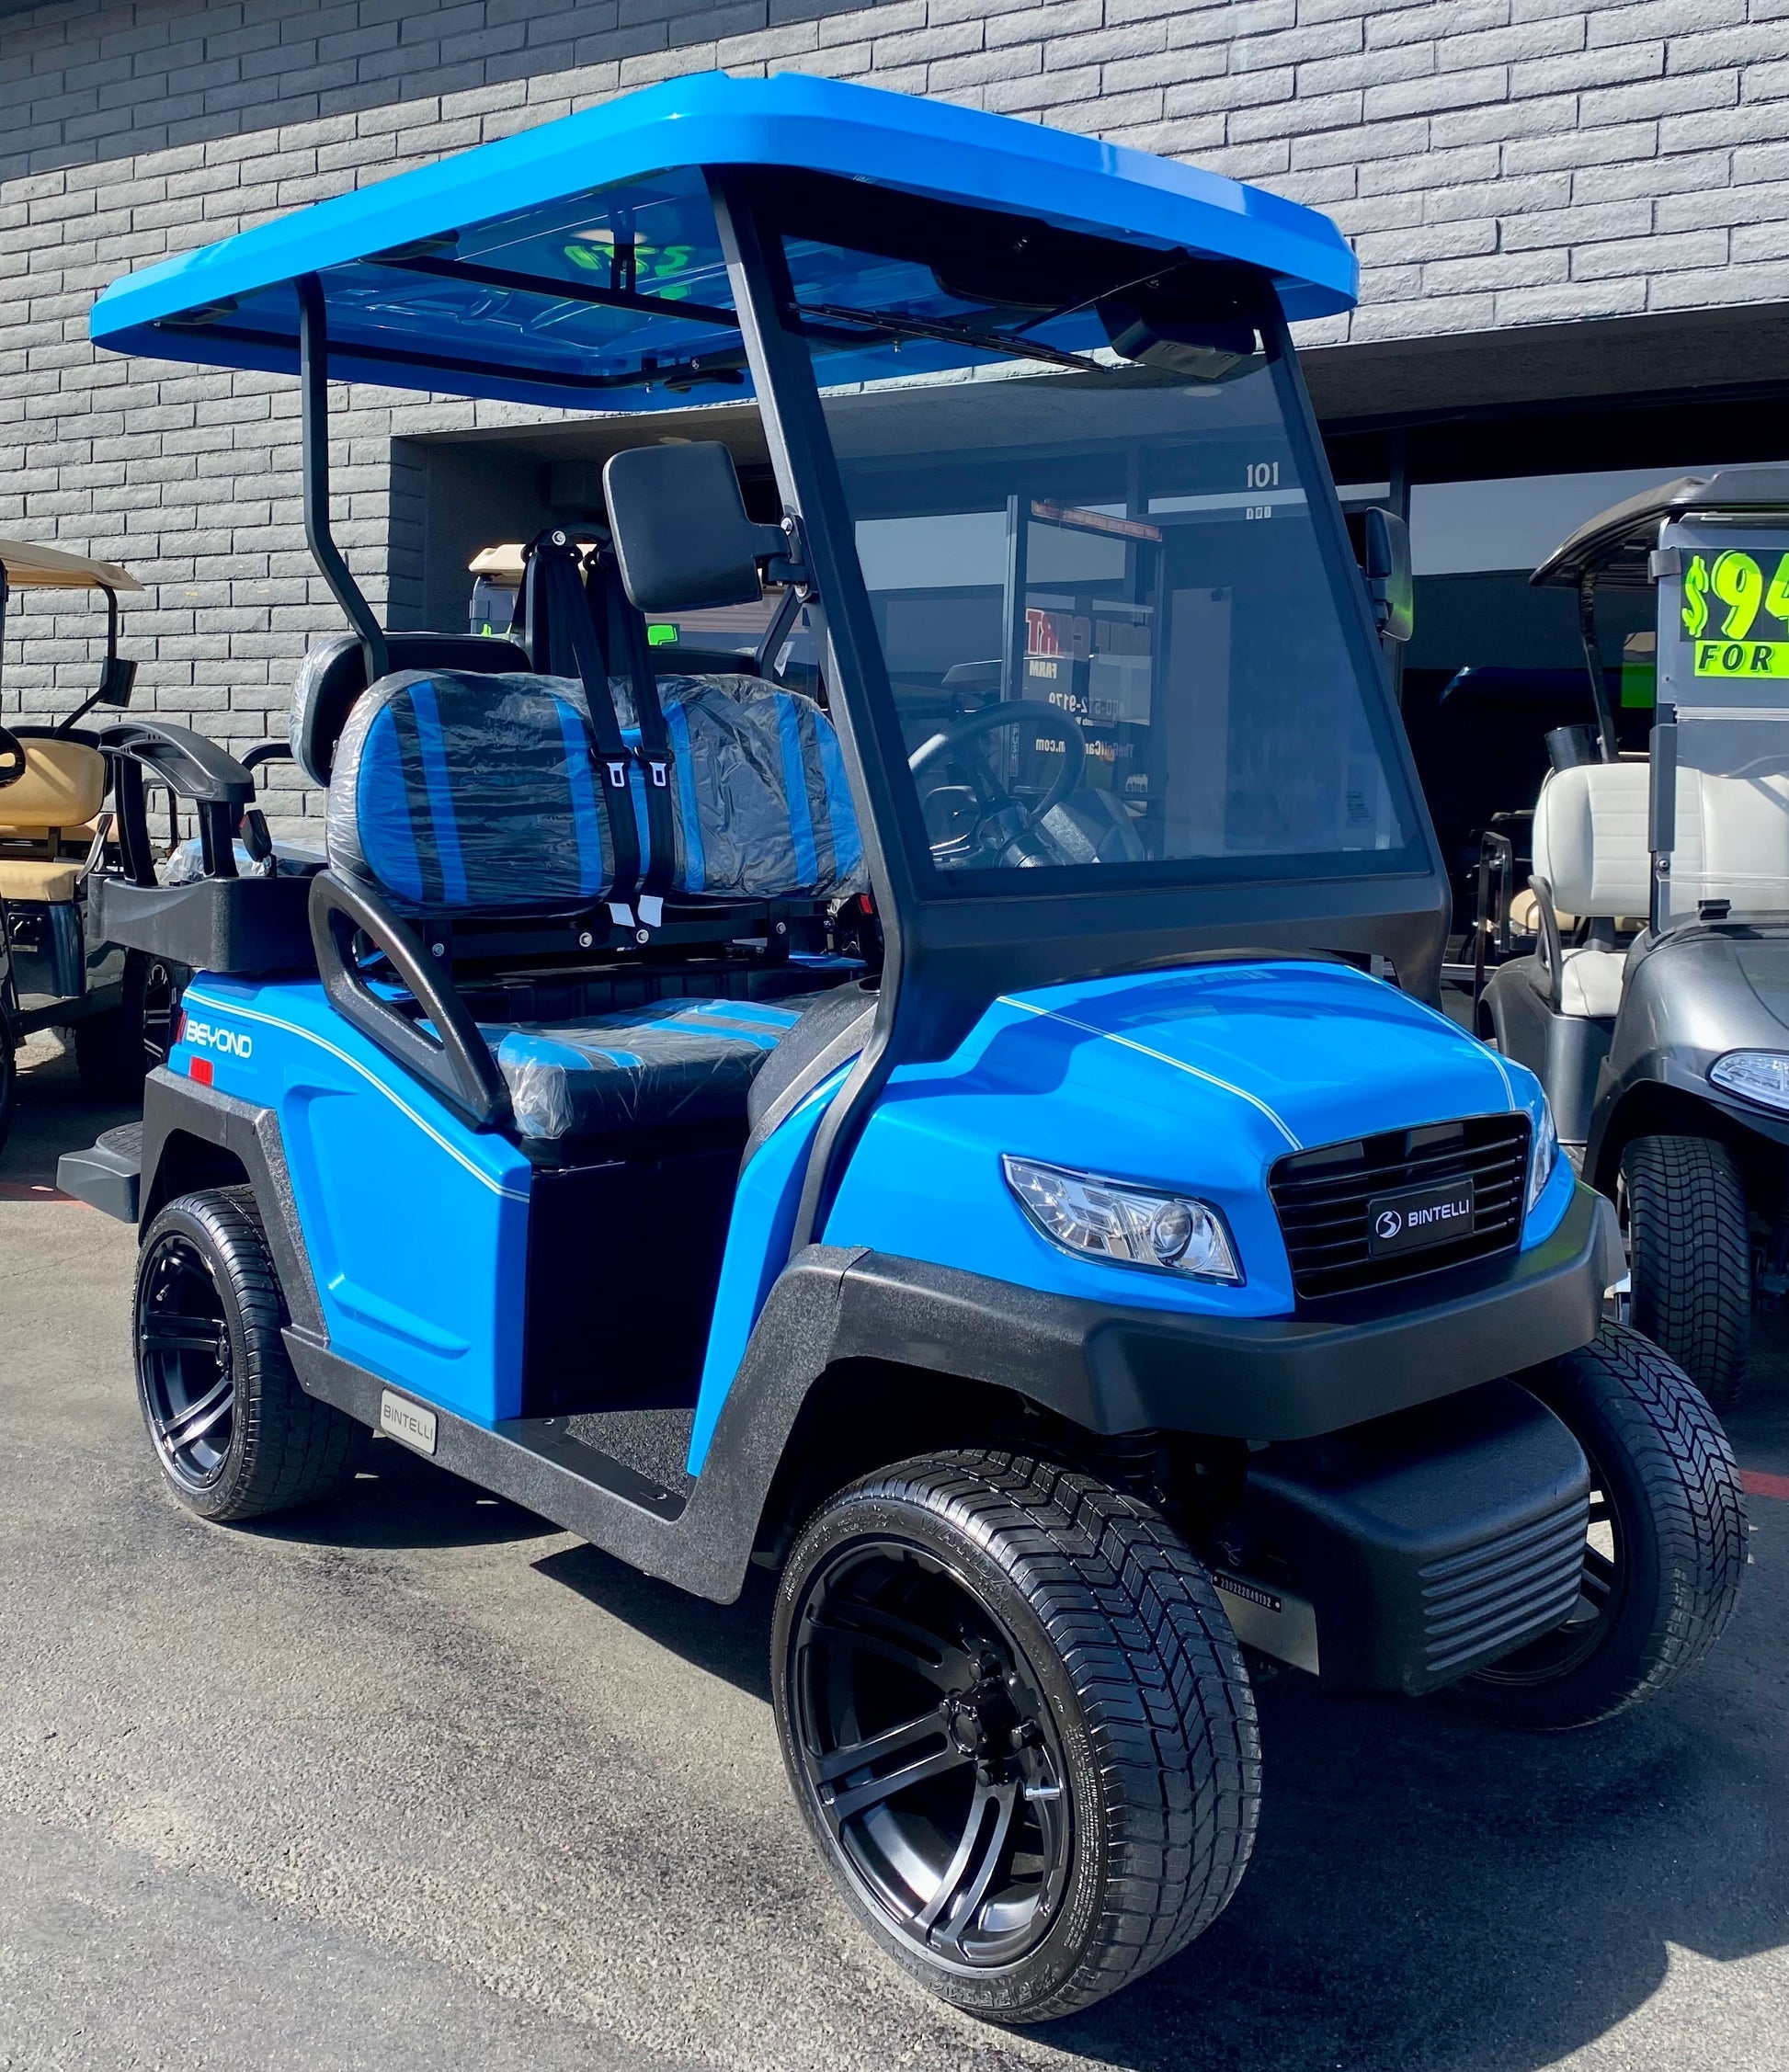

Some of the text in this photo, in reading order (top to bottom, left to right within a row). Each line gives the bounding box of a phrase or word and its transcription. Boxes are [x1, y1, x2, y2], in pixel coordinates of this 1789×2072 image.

[1246, 461, 1280, 488] 101
[1698, 643, 1774, 674] FOR
[1011, 726, 1020, 763] PUSH
[187, 1020, 252, 1058] BEYOND
[1407, 1198, 1470, 1228] BINTELLI
[383, 1404, 434, 1441] BINTELLI
